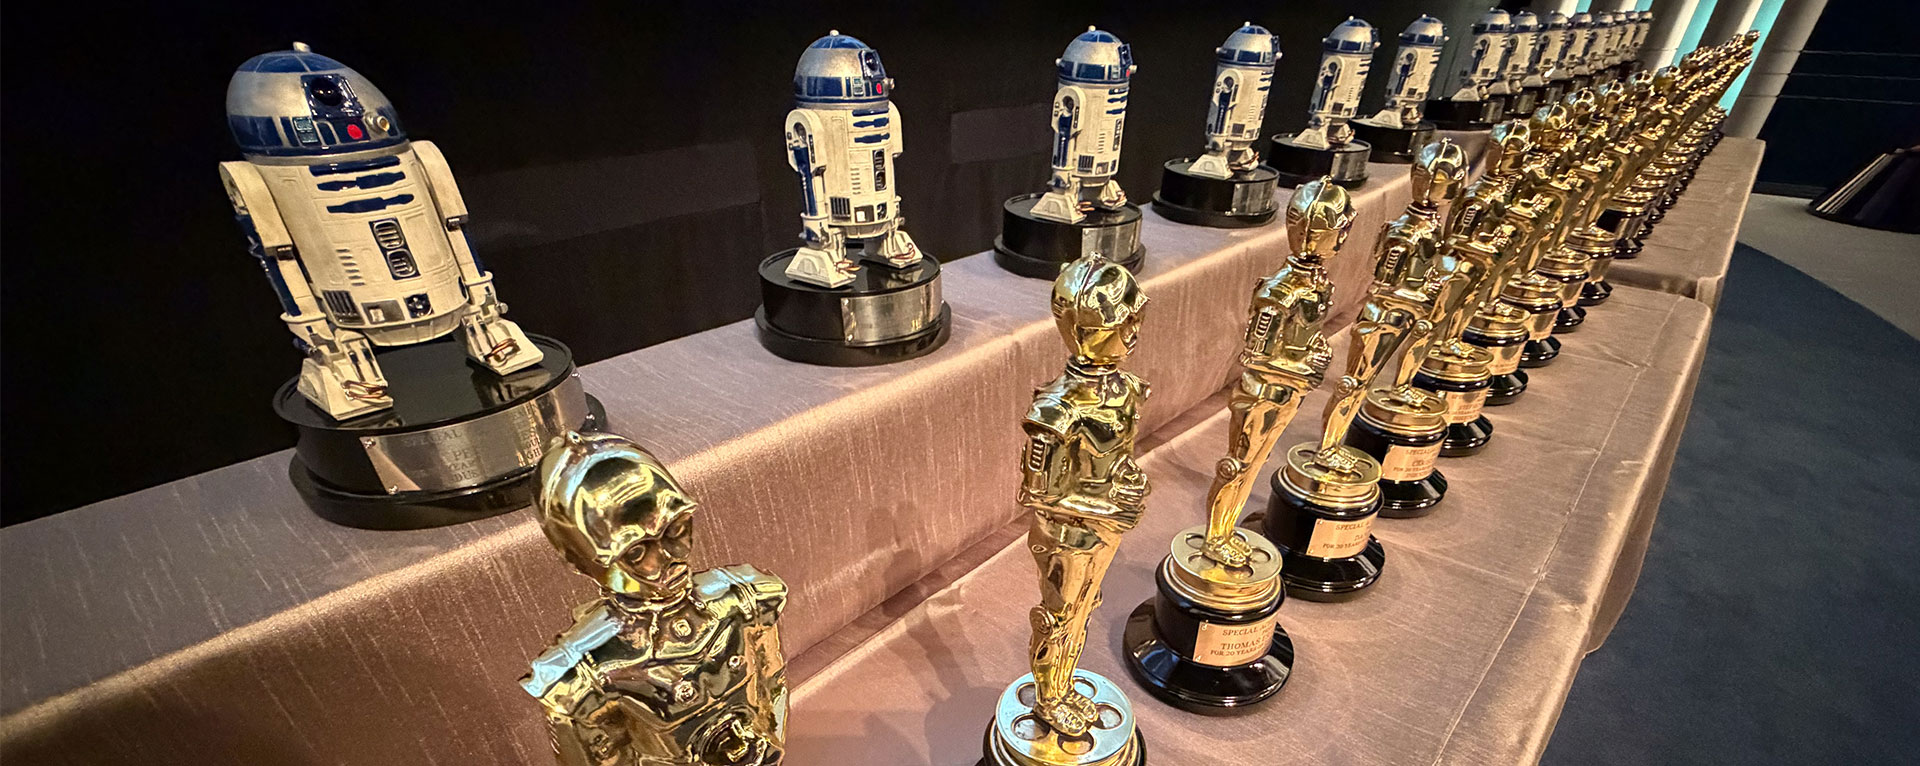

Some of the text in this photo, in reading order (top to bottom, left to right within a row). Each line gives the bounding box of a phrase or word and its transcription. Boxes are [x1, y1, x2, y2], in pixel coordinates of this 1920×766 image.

[1335, 522, 1364, 531] SPECIAL
[1222, 626, 1258, 636] SPECIAL
[1220, 637, 1262, 650] THOMAS
[1236, 646, 1258, 656] YEARS
